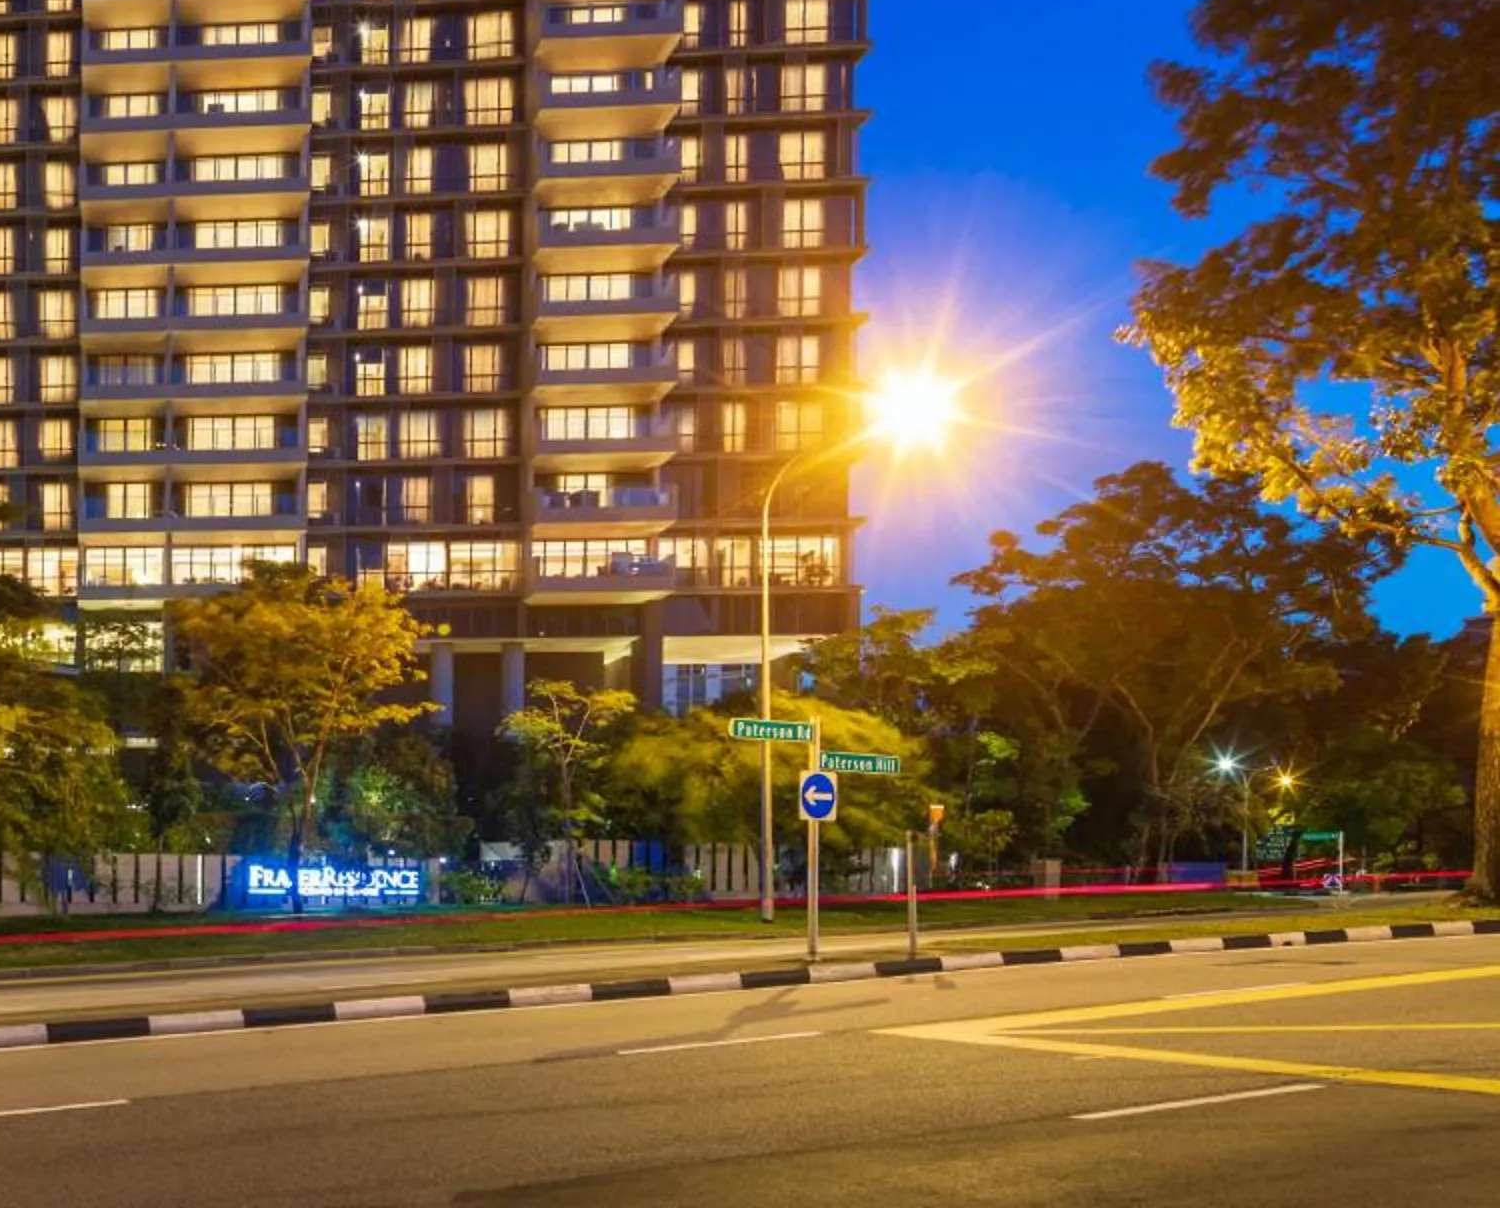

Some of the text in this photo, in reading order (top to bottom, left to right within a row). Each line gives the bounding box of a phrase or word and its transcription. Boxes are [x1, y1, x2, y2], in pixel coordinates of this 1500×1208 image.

[737, 721, 811, 739] Paterson Rd
[821, 753, 895, 772] Paterson Hill
[249, 865, 321, 888] FRAER
